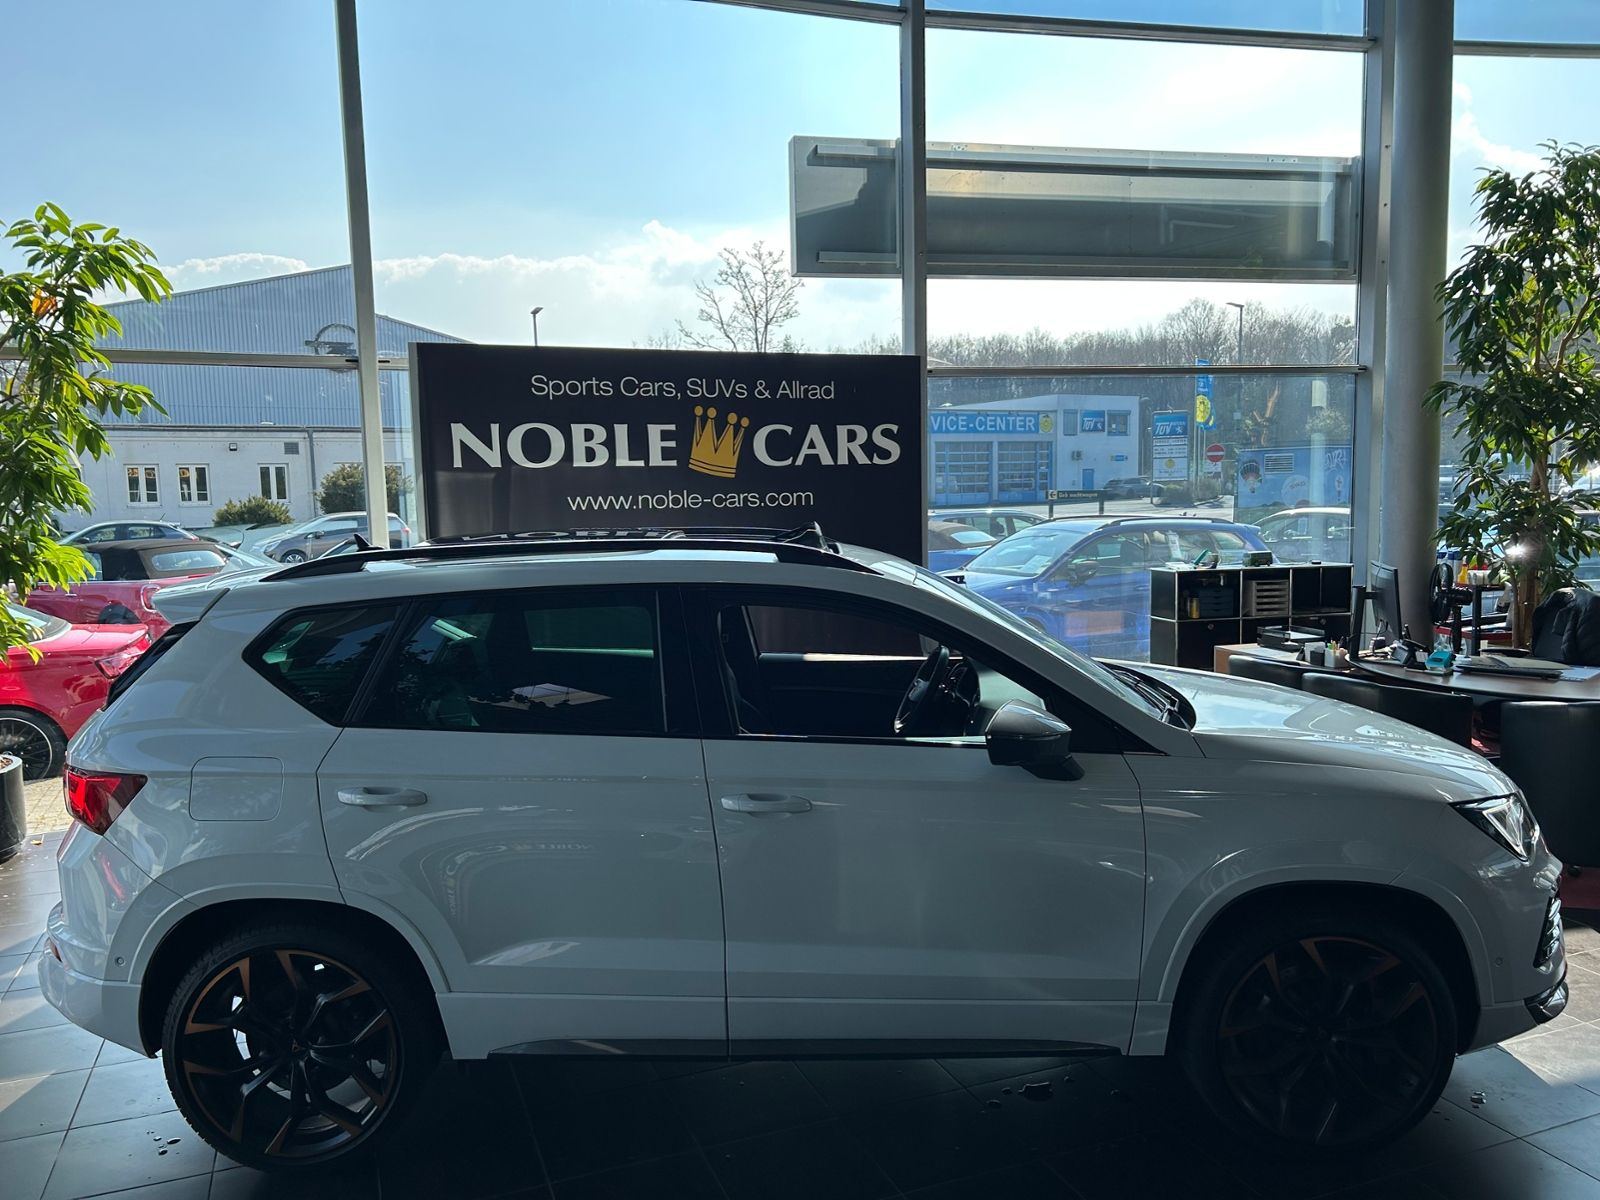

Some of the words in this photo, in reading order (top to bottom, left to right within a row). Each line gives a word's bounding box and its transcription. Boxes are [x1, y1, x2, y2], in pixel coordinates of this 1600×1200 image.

[531, 375, 613, 400] Sports
[621, 376, 682, 400] Cars,
[686, 377, 748, 399] SUVs
[754, 380, 771, 399] &
[776, 380, 835, 400] Allrad
[450, 422, 678, 470] NOBLE
[753, 423, 902, 467] CARS
[566, 490, 815, 511] www.noble-cars.com
